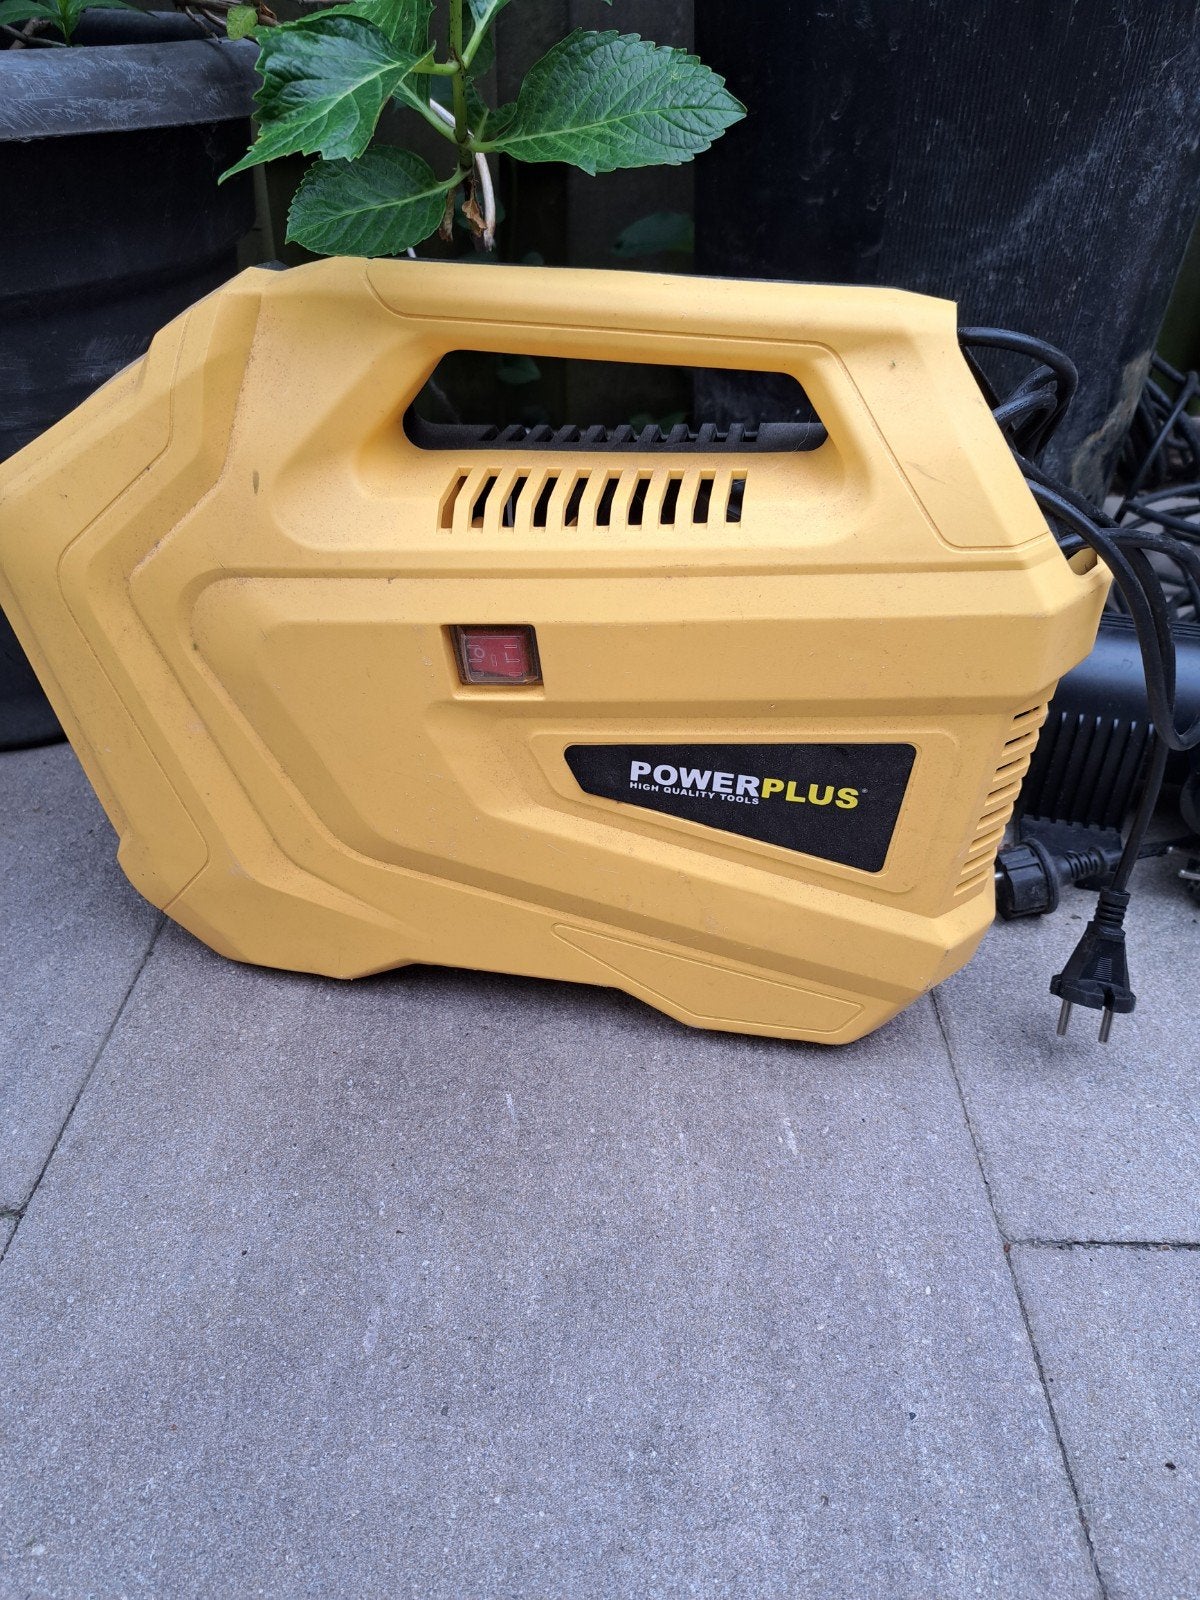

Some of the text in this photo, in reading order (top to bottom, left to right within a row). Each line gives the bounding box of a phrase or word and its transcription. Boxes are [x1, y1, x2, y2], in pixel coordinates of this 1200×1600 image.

[629, 781, 760, 806] HIGH QUALITY TOOLS
